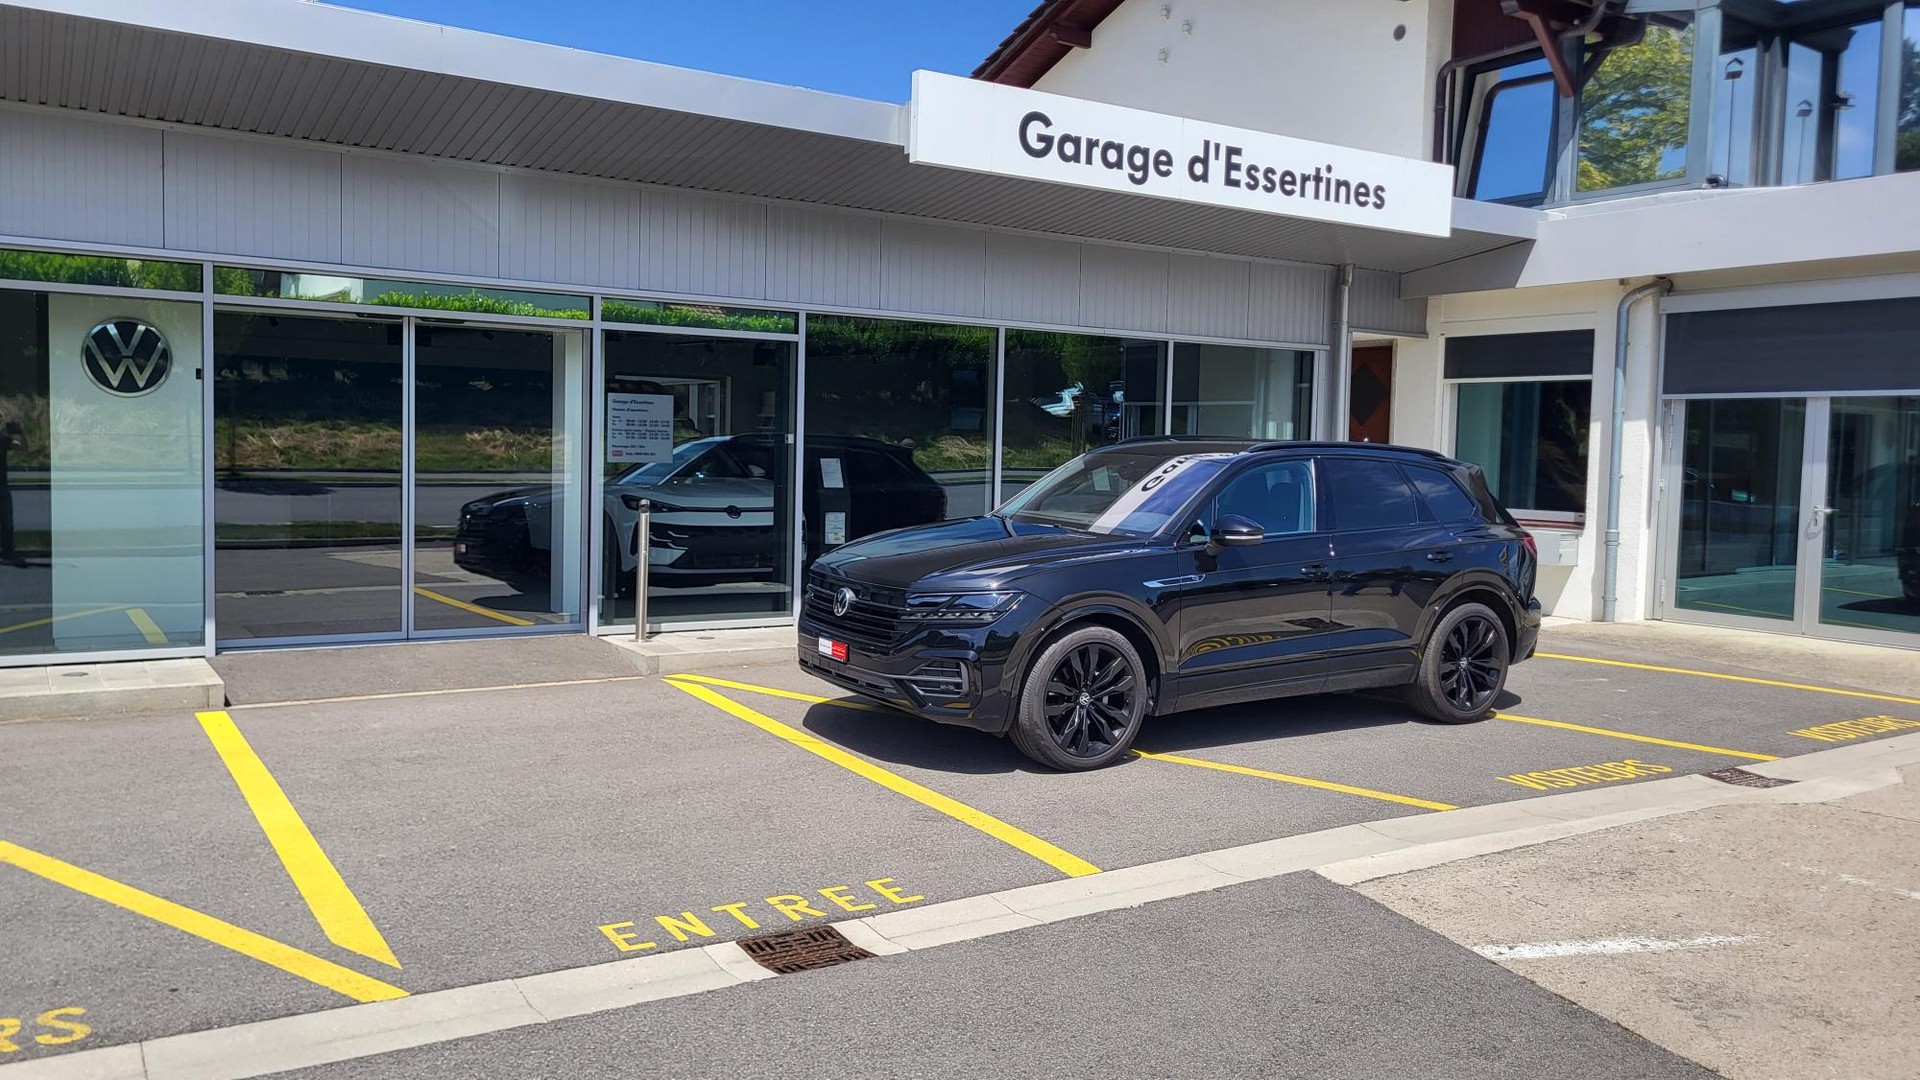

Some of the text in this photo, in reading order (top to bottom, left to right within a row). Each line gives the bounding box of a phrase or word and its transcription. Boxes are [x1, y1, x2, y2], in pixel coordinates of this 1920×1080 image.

[1018, 111, 1386, 210] Garage d'Essertines
[1494, 759, 1673, 791] VISITEURS
[597, 877, 925, 952] ENTREE
